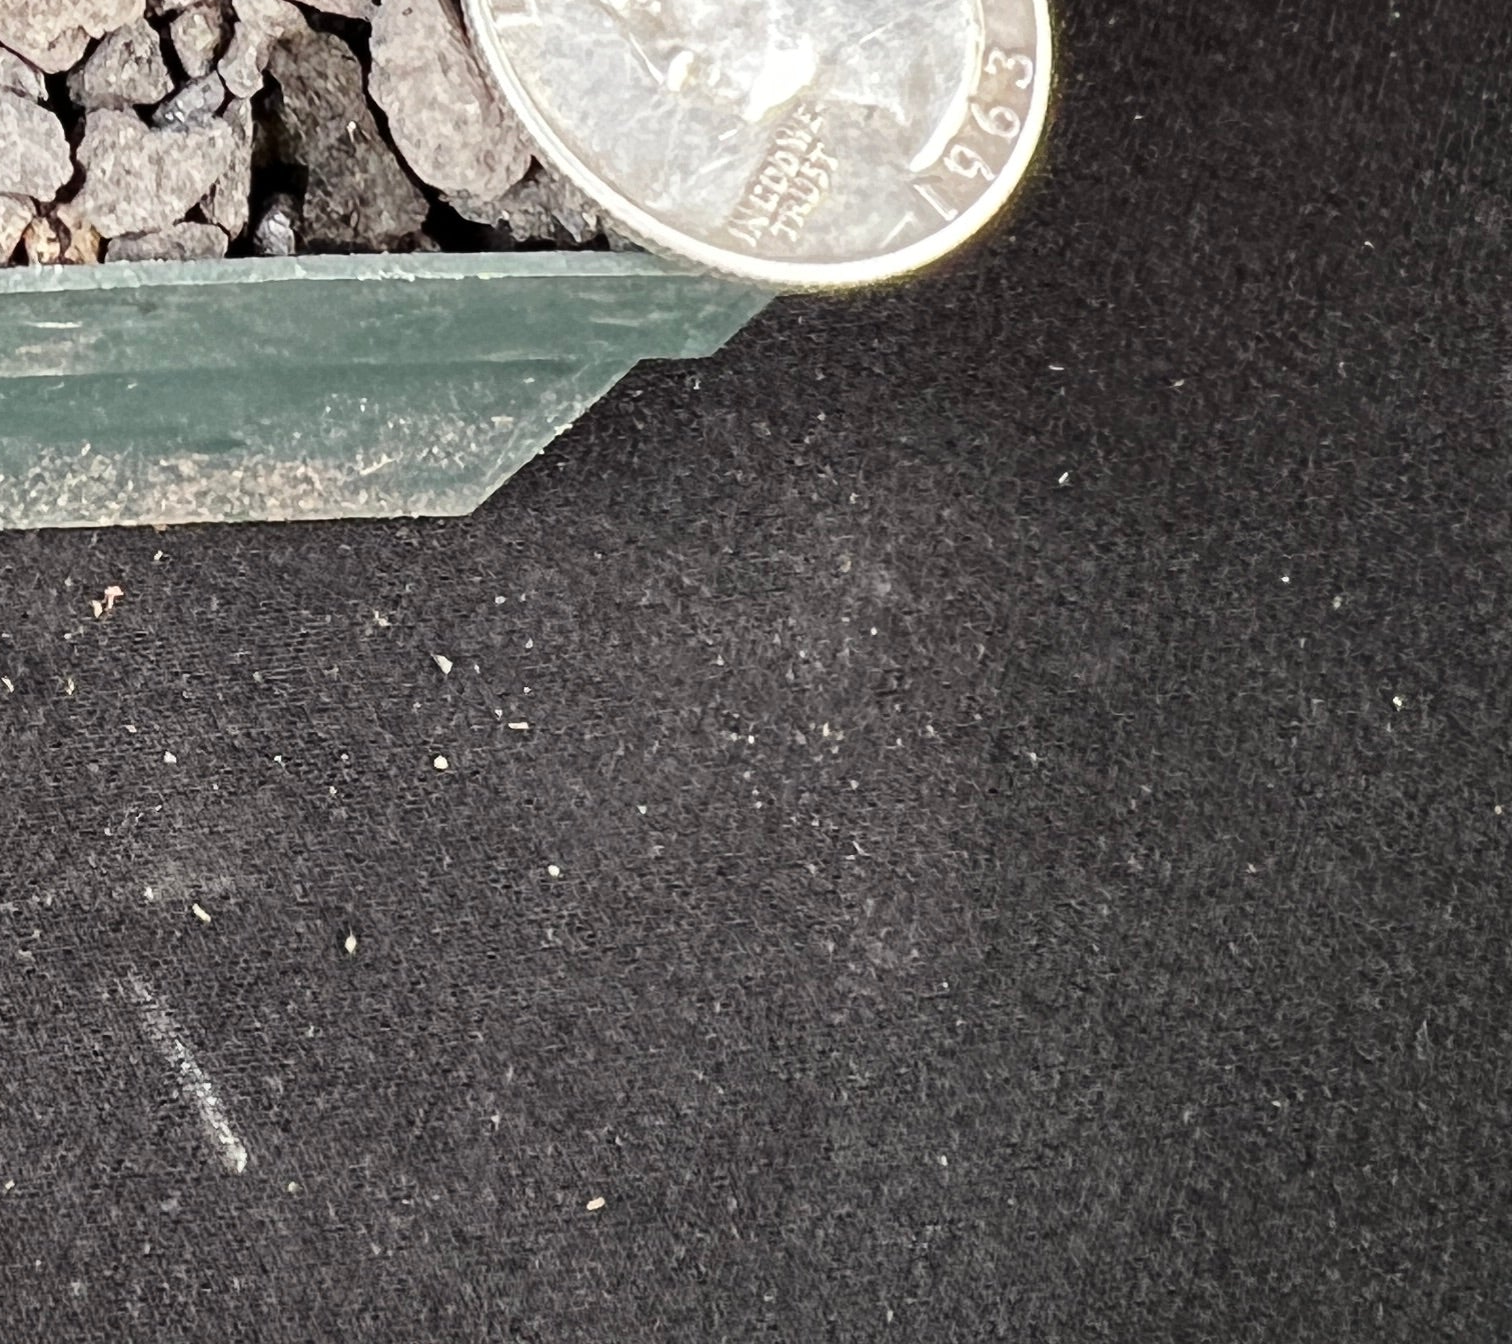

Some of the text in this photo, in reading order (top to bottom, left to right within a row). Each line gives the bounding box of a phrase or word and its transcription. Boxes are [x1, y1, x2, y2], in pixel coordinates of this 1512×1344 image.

[748, 149, 801, 213] GOD
[912, 47, 1034, 222] 1963
[769, 142, 838, 243] TRUST
